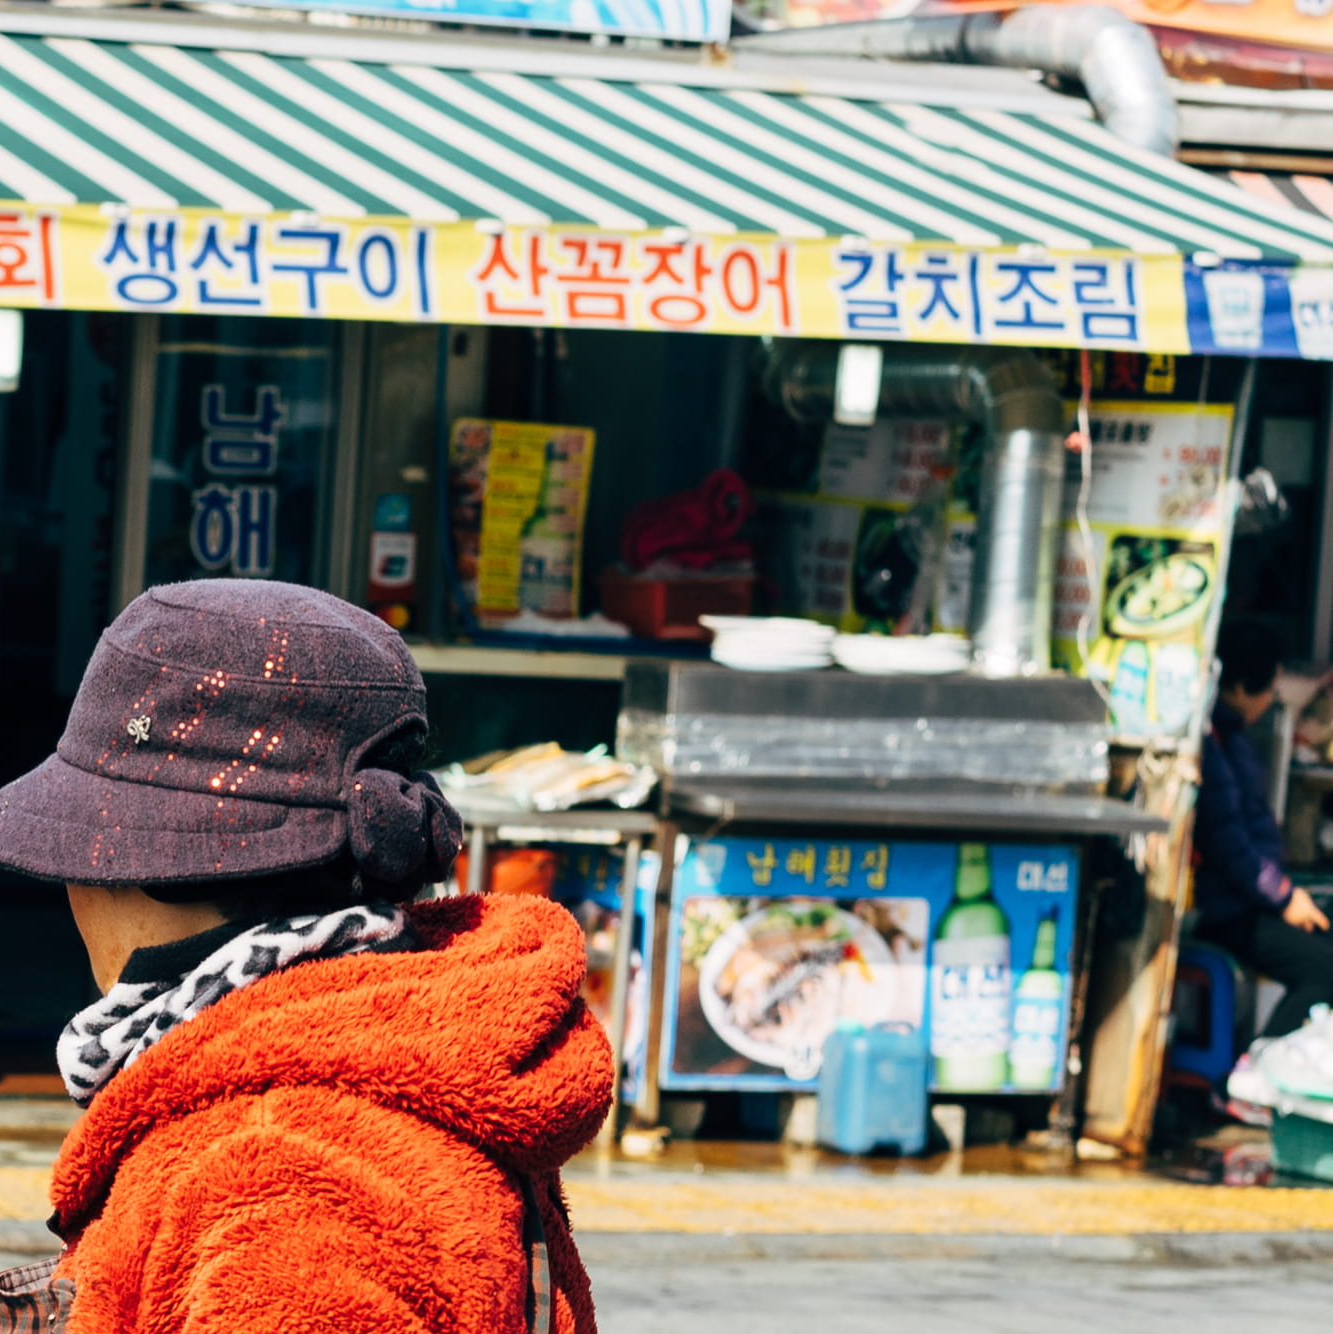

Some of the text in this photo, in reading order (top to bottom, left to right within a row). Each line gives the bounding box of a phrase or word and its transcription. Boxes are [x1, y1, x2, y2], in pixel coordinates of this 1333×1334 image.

[103, 217, 431, 315] 생선구이
[476, 233, 793, 330] 산꼼장어
[837, 251, 1139, 342] 갈치조림
